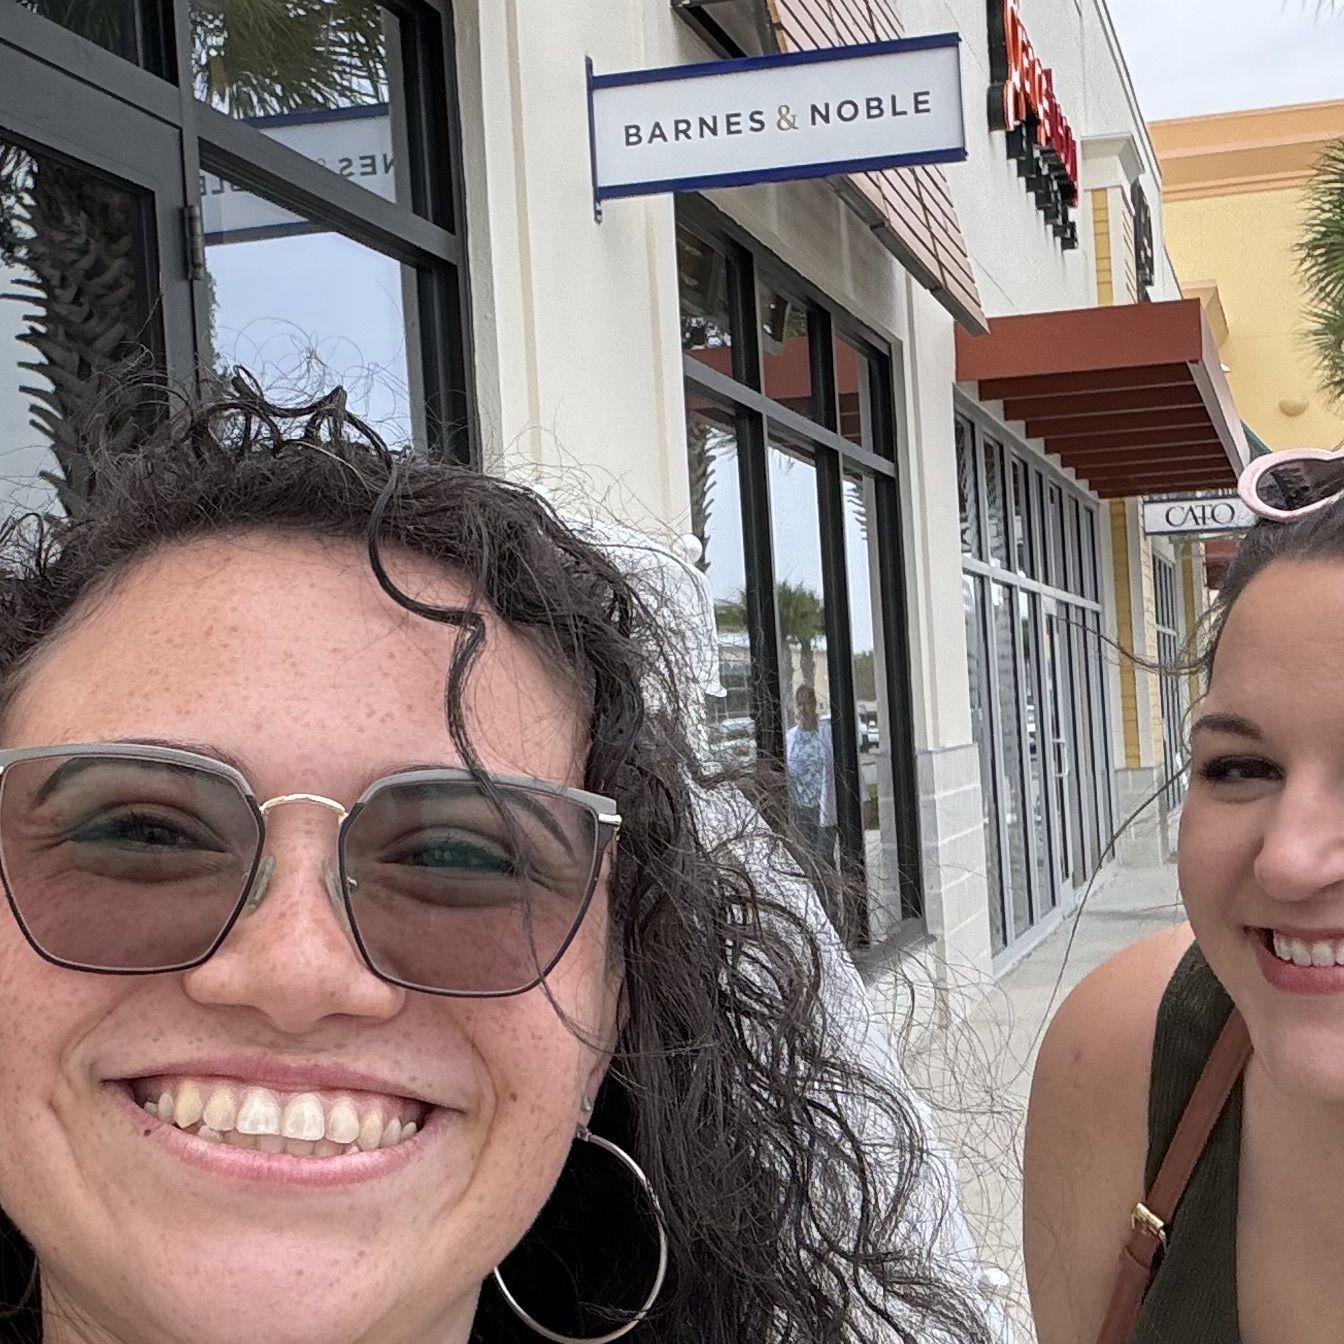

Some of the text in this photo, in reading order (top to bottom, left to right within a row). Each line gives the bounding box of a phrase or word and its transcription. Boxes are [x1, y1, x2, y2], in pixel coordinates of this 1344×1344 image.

[625, 91, 931, 147] BARNES & NOBLE
[1165, 502, 1236, 528] CATO
